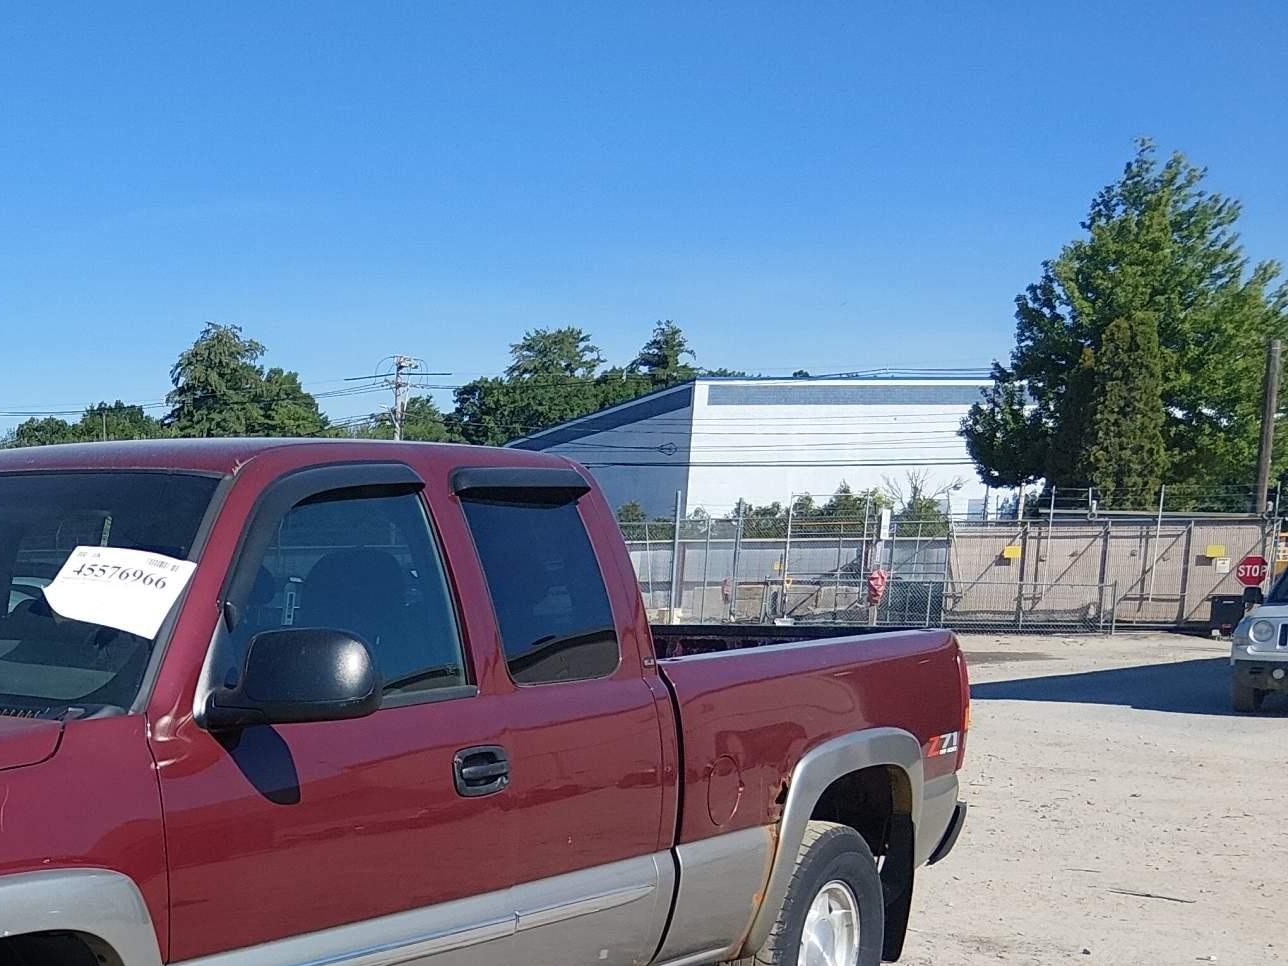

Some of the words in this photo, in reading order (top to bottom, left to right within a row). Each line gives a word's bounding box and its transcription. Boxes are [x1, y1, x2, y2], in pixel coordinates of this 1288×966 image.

[73, 563, 168, 589] 45576966
[1238, 565, 1268, 577] STOP
[927, 731, 958, 758] Z71
